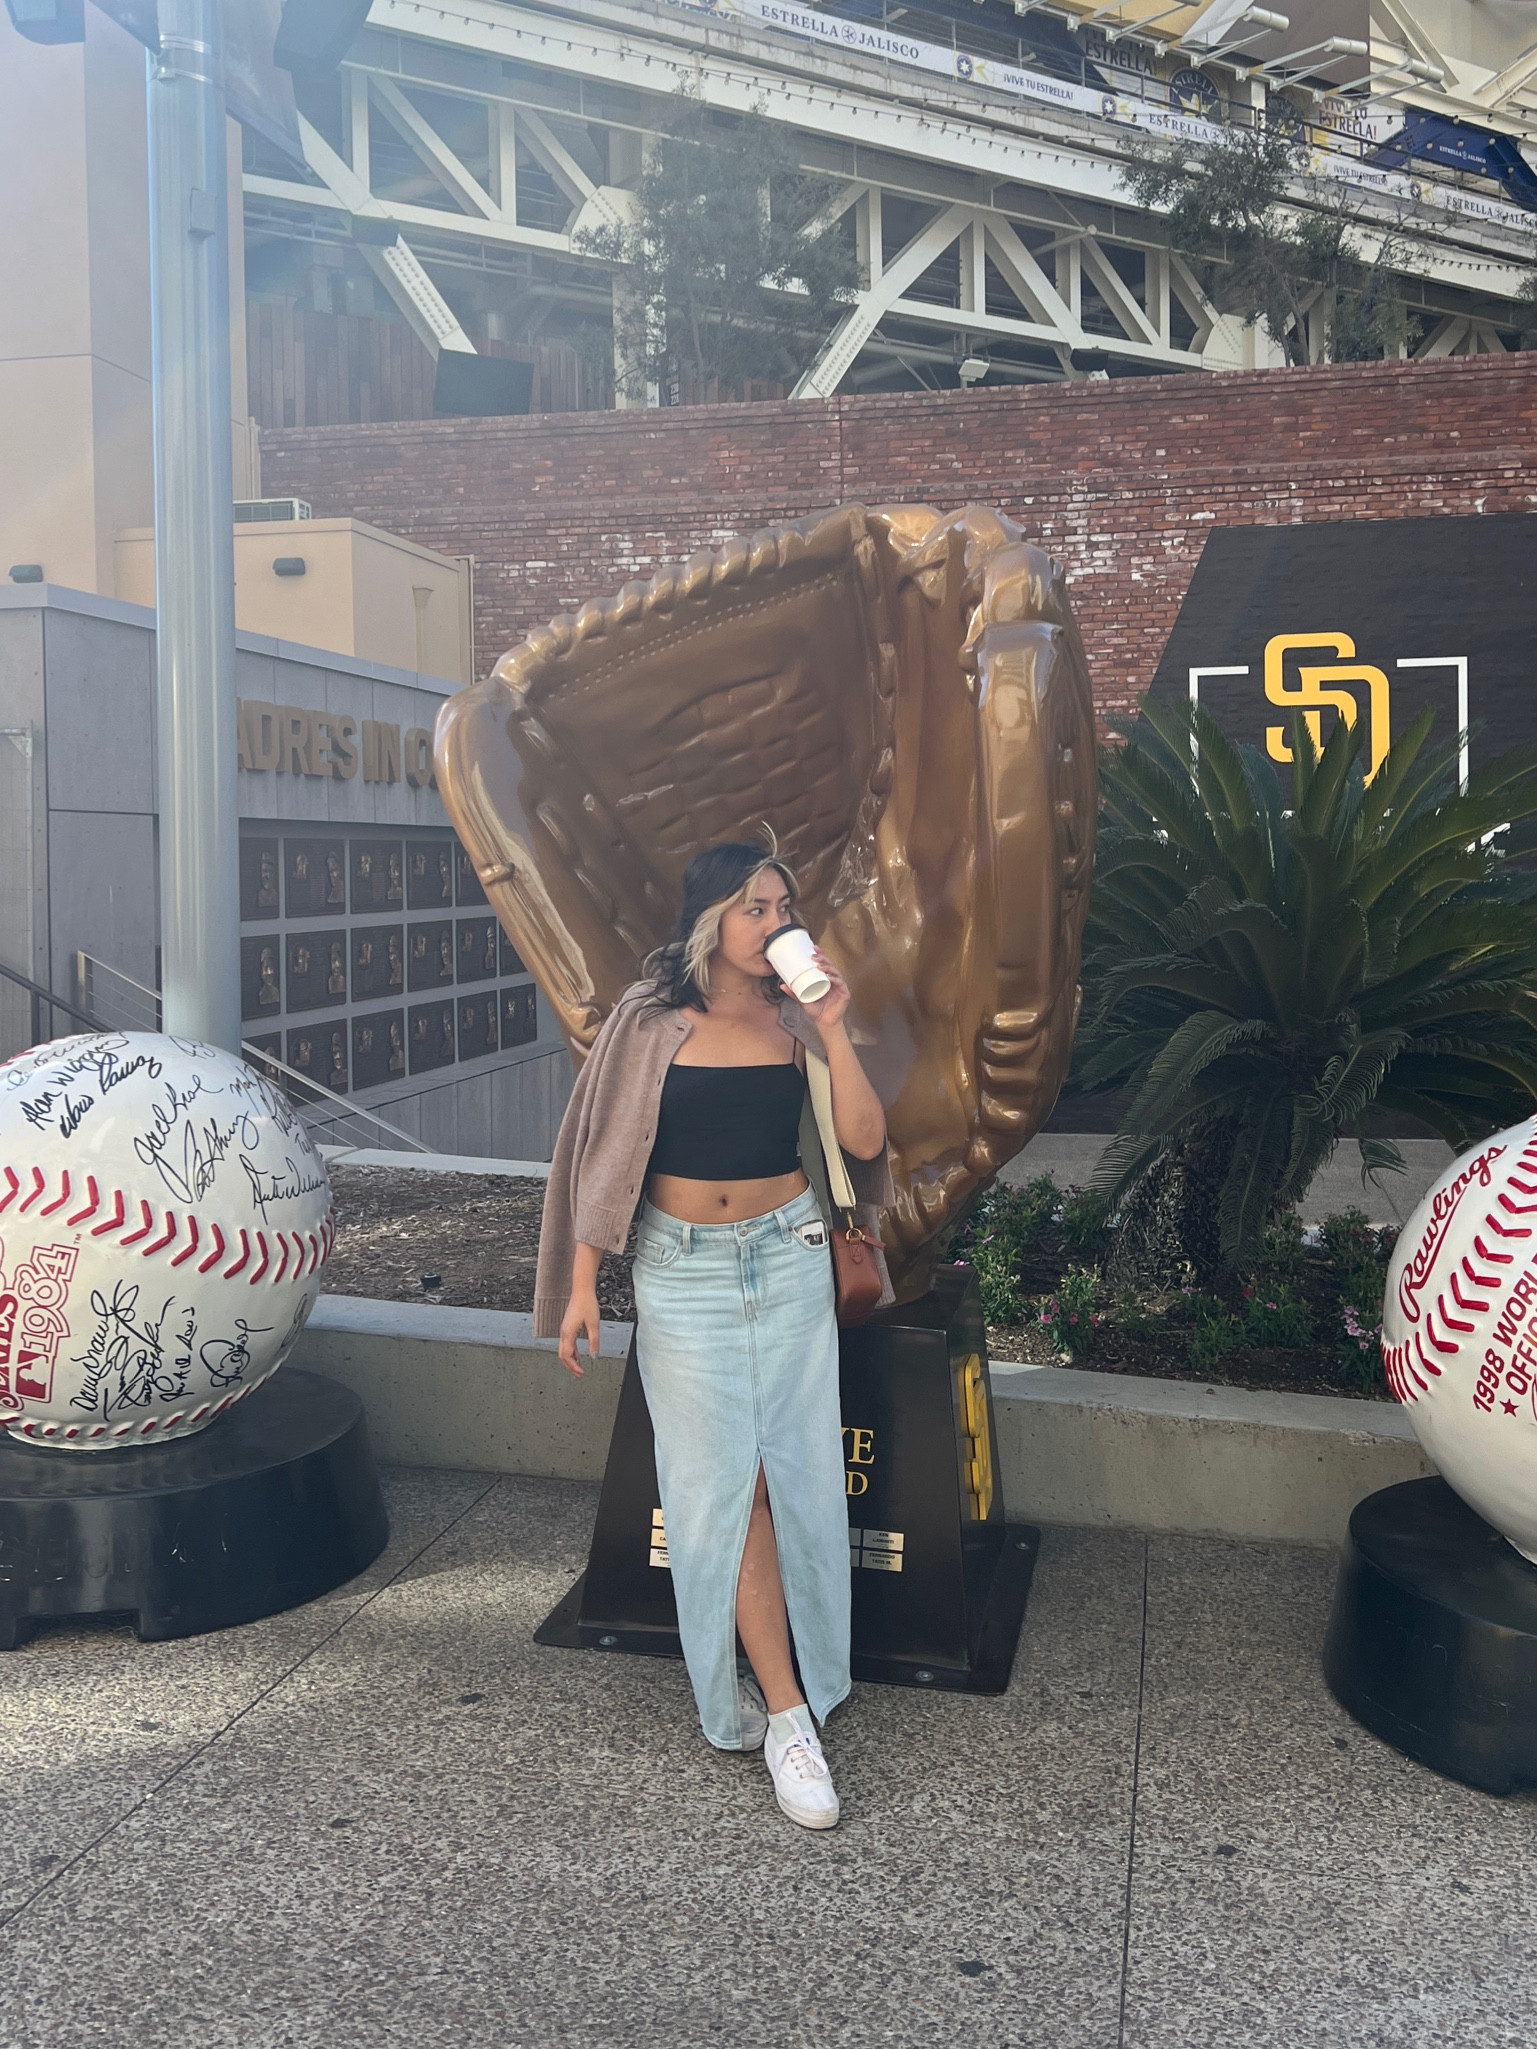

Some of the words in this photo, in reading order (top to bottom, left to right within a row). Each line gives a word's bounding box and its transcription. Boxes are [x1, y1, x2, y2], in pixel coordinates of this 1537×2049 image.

[760, 4, 839, 38] ESTRELLA
[858, 32, 919, 59] JALISCO
[1026, 79, 1036, 90] TU
[1036, 83, 1074, 100] ESTRELLA!
[362, 720, 401, 784] IN
[1399, 1144, 1508, 1324] Rawlings
[16, 1243, 79, 1357] 1984
[1473, 1348, 1505, 1413] 1998
